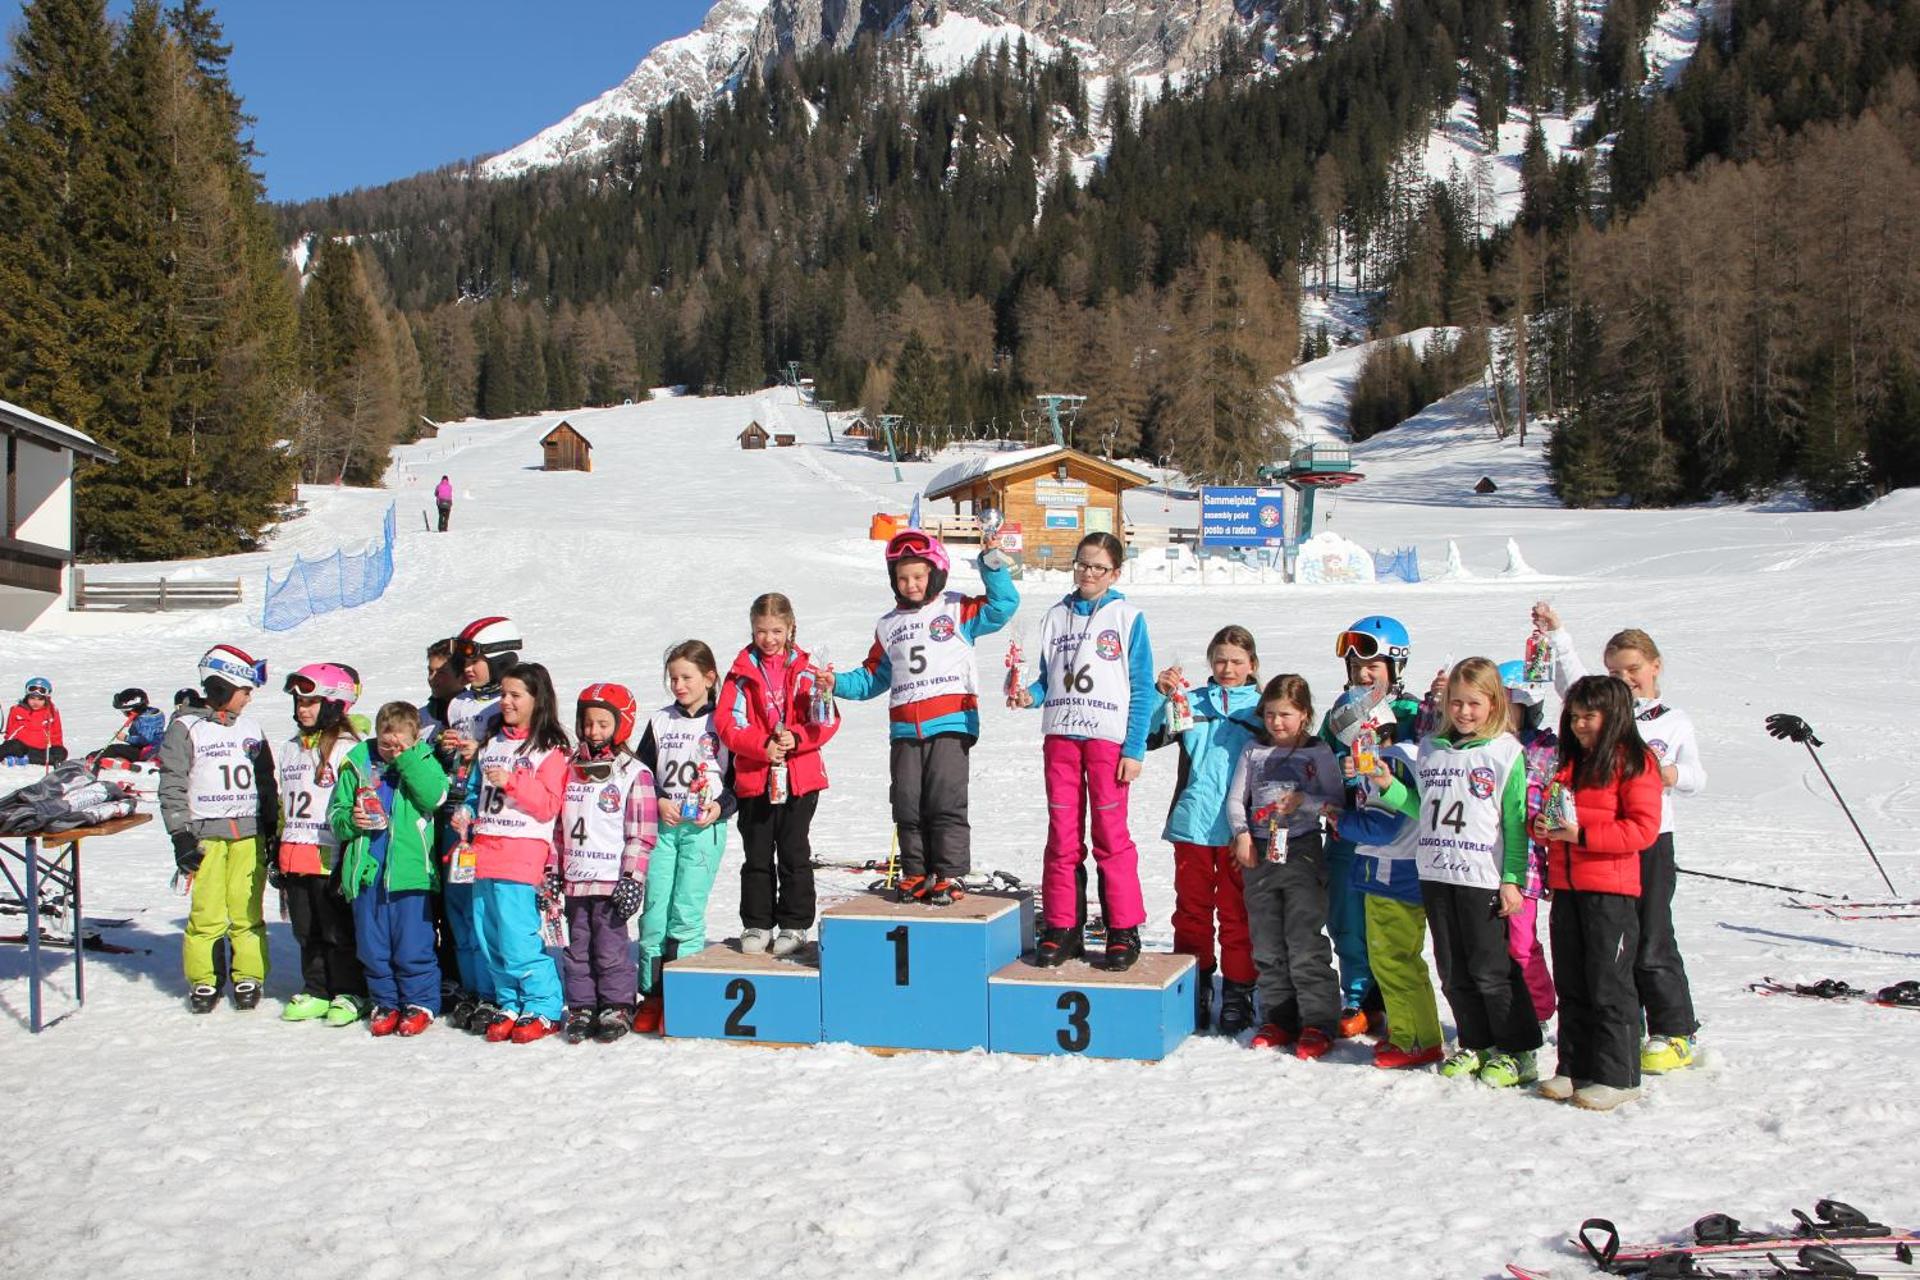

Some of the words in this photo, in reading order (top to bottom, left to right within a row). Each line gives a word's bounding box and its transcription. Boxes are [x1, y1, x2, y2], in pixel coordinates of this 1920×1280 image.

[1204, 494, 1256, 507] Sammelplatz
[1204, 511, 1232, 521] assembly
[1234, 511, 1249, 521] point
[1204, 525, 1224, 537] posto
[1232, 525, 1256, 535] raduno
[910, 622, 923, 630] SKI
[909, 645, 927, 674] 5
[930, 675, 960, 685] VERLEIH
[1072, 697, 1085, 706] SKI
[1088, 699, 1118, 712] VERLEIH
[682, 732, 694, 740] SKI
[219, 765, 251, 790] 10
[663, 760, 699, 788] 20
[1449, 768, 1464, 778] SKI
[198, 794, 234, 802] NOLEGGIO
[289, 791, 312, 819] 12
[484, 785, 504, 815] 15
[1432, 799, 1466, 834] 14
[571, 816, 587, 846] 4
[1442, 838, 1456, 848] SKI
[586, 851, 616, 860] VERLEIH
[886, 925, 909, 986] 1
[724, 978, 757, 1038] 2
[1056, 990, 1091, 1052] 3
